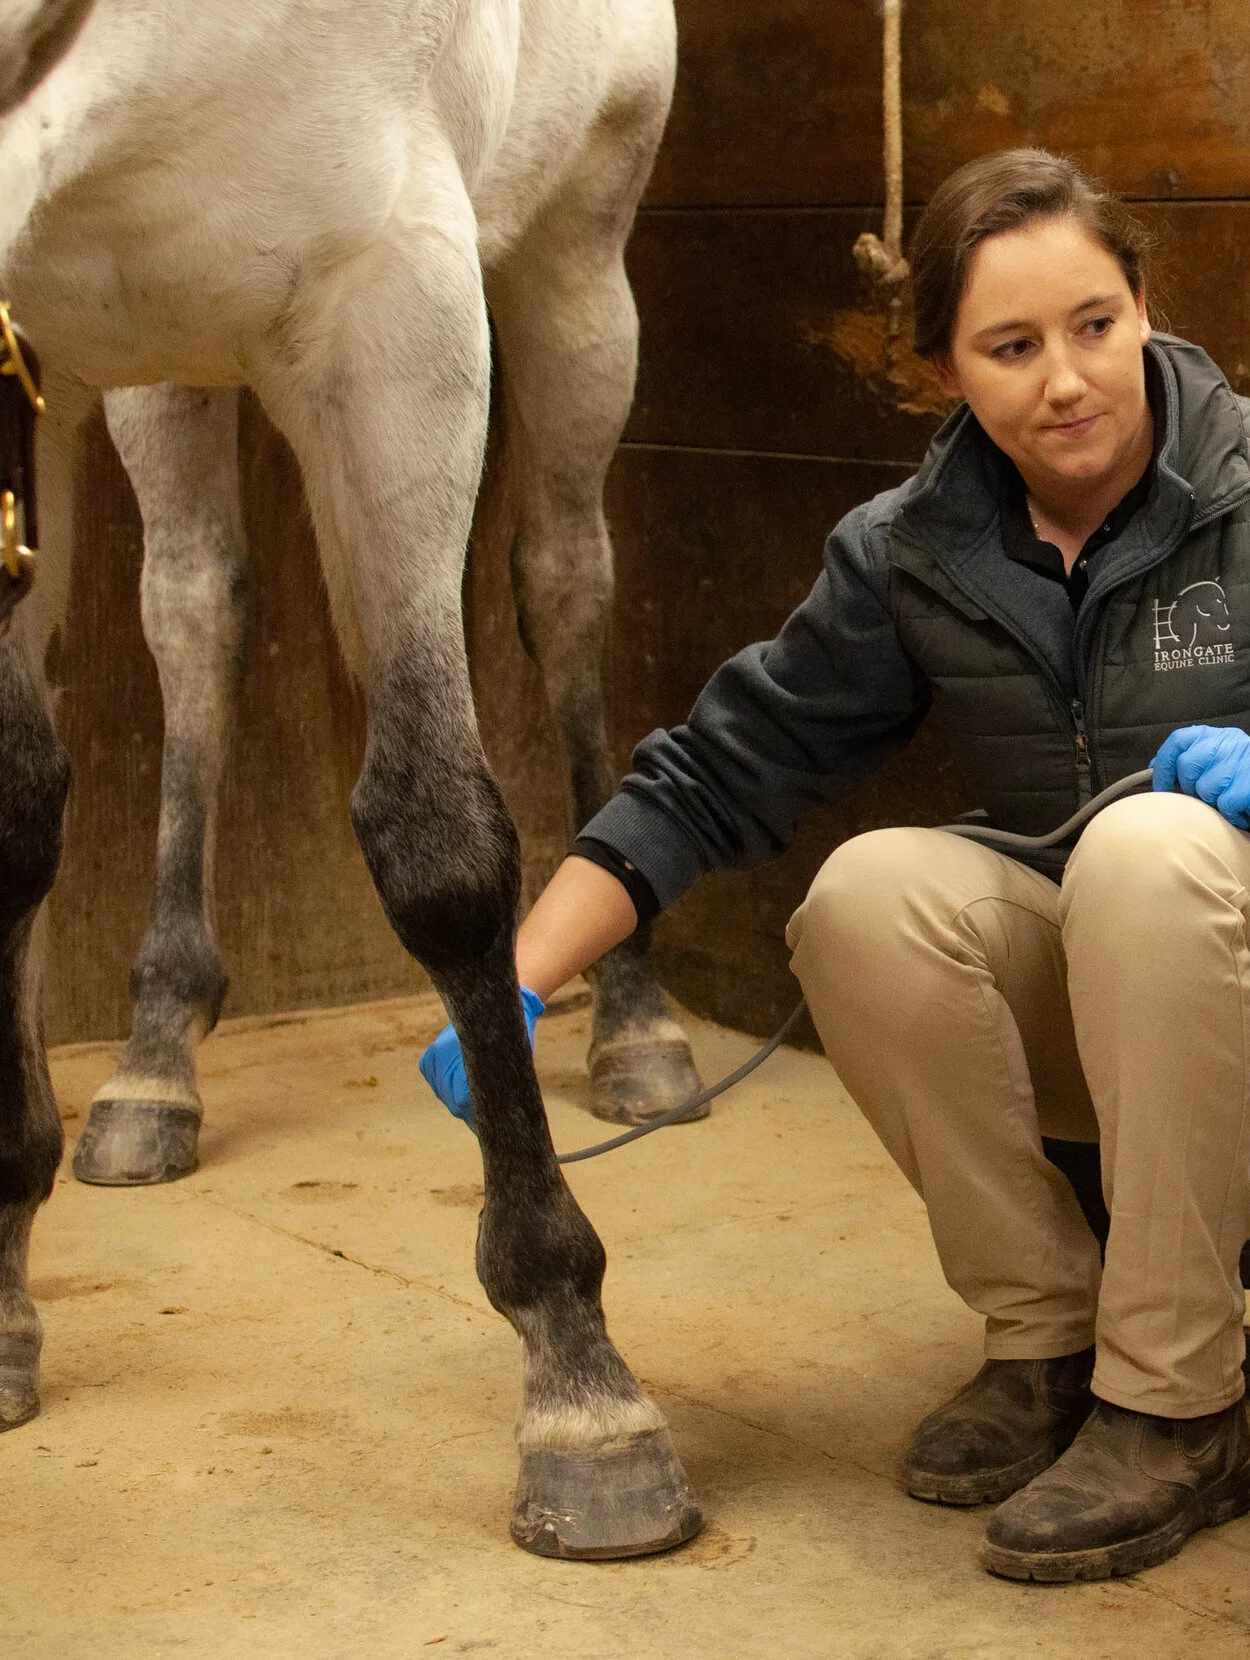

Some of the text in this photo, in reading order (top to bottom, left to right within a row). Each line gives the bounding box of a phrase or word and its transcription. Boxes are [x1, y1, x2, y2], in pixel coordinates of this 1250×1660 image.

[1154, 643, 1234, 663] IRONGATE
[1154, 654, 1235, 671] EQUINE CLINIC
